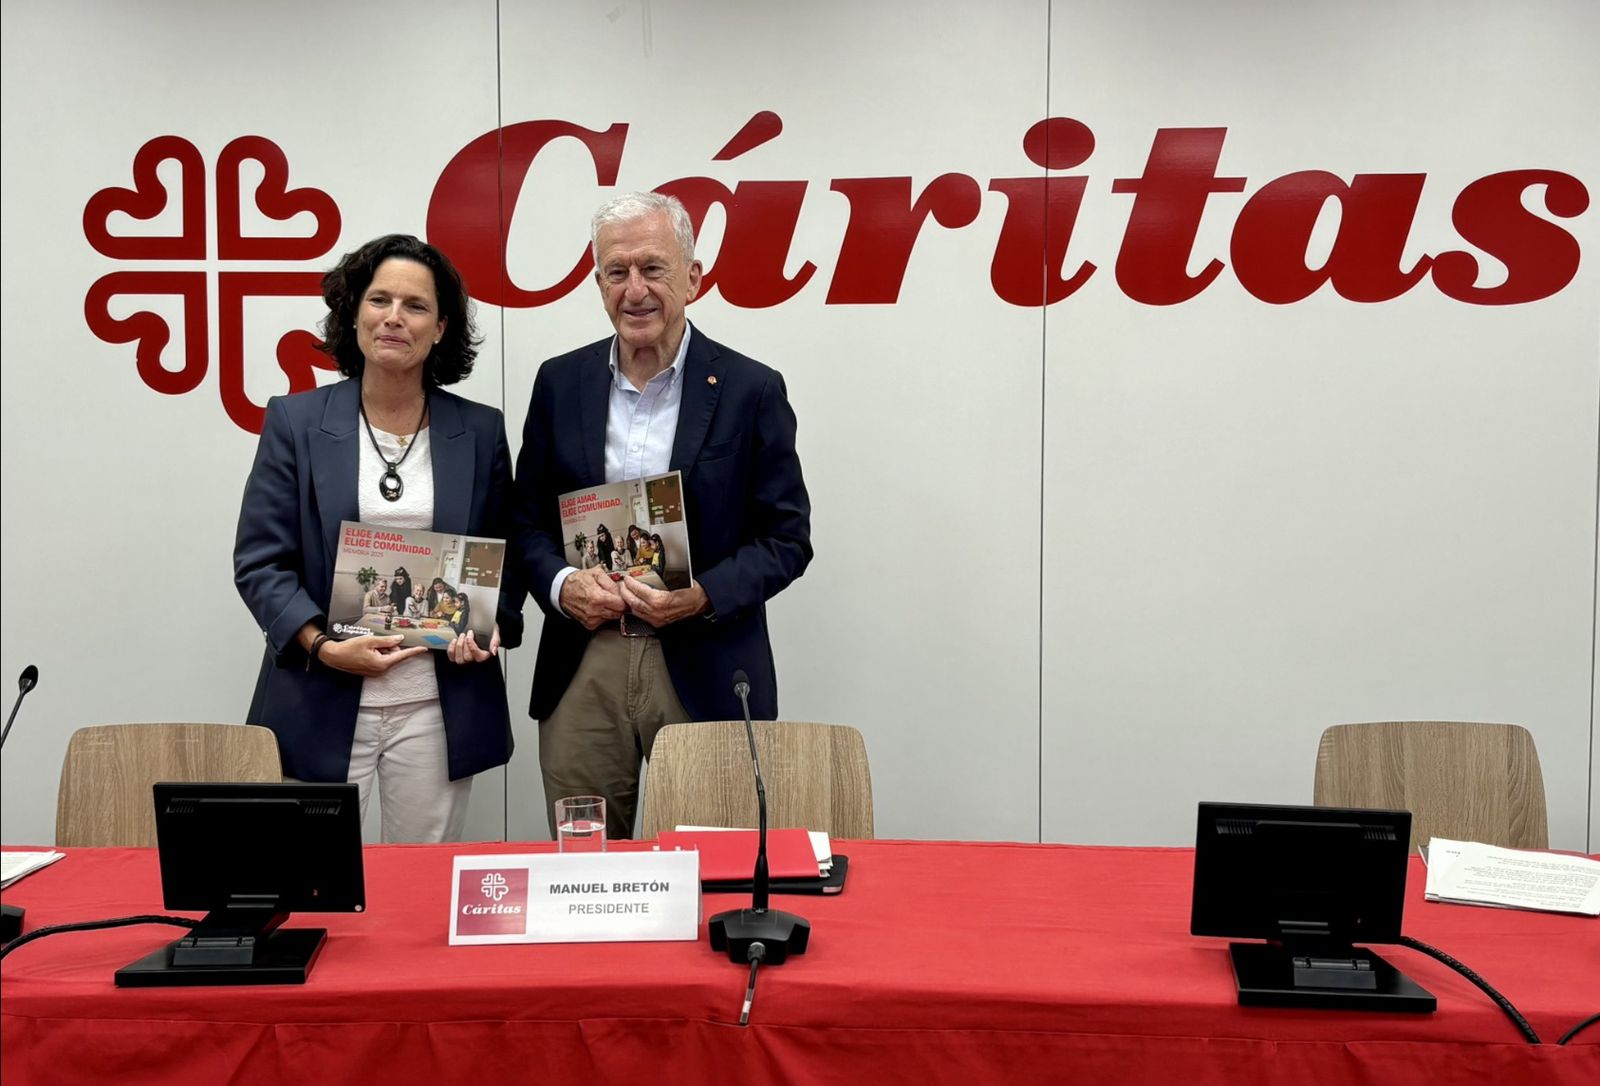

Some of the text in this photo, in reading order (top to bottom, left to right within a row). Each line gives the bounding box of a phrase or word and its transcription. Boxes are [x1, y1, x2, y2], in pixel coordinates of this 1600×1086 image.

[427, 111, 1590, 308] Cáritas
[562, 499, 576, 509] ELIGE
[562, 499, 621, 517] ELIGE COMUNIDAD.
[345, 528, 405, 542] ELIGE AMAR.
[344, 537, 432, 555] ELIGE COMUNIDAD.
[549, 880, 670, 895] MANUEL BRETÓN
[462, 904, 522, 915] Cáritas
[568, 903, 650, 914] PRESIDENTE
